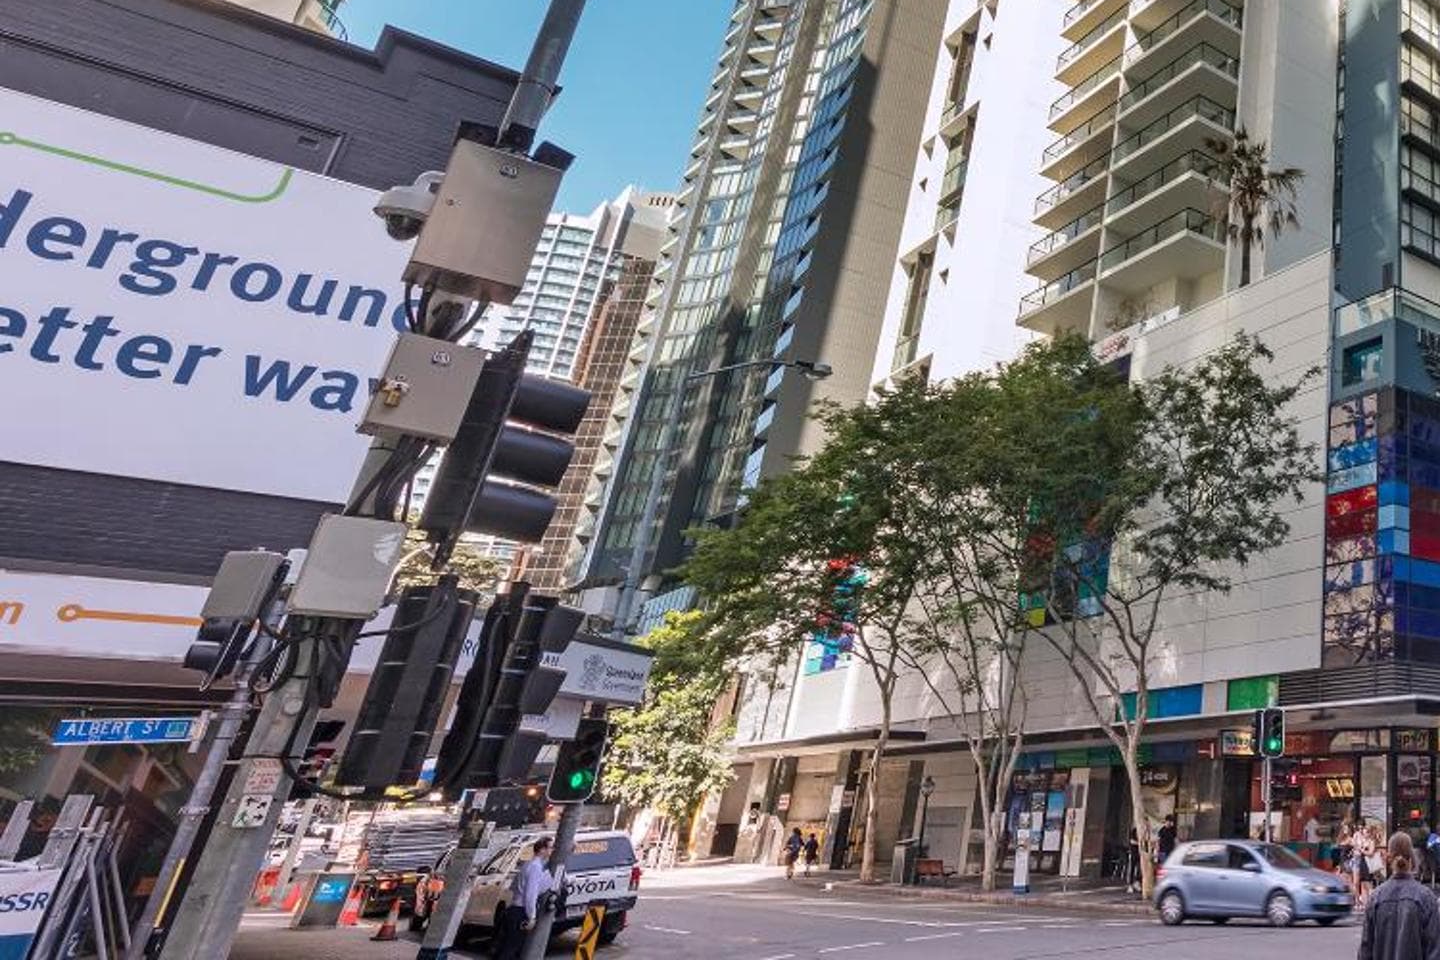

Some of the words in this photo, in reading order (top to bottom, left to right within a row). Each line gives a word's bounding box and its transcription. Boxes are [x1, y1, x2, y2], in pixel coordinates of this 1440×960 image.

[243, 353, 381, 414] wa
[64, 720, 134, 737] ALBERT
[566, 880, 616, 895] OYOTA
